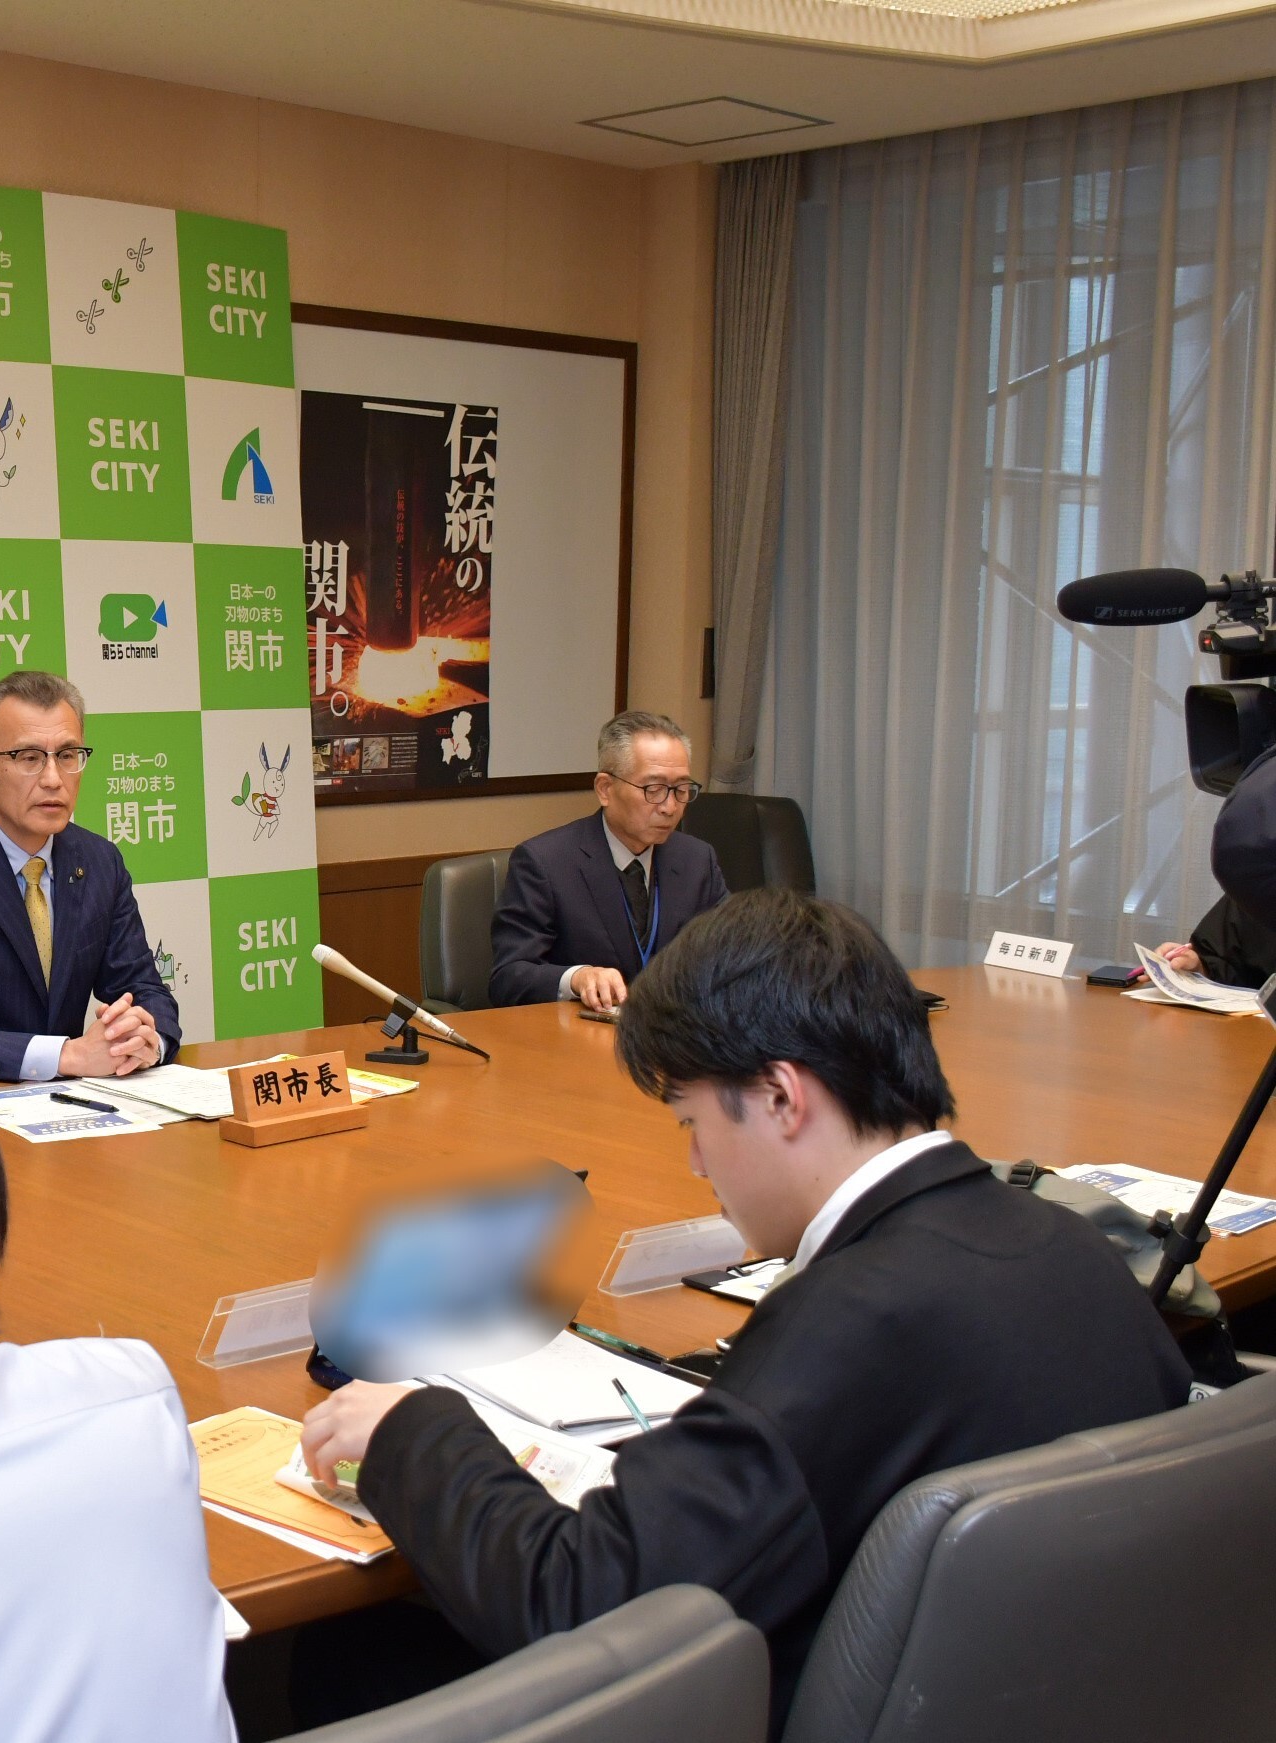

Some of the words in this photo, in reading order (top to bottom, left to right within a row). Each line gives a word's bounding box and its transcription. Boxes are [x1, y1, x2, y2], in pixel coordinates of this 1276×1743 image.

[207, 263, 266, 299] SEKI
[209, 304, 266, 338] CITY
[88, 418, 159, 450] SEKI
[91, 461, 159, 493] CITY
[254, 495, 274, 504] SEKI
[444, 403, 498, 592] 伝統の
[230, 584, 276, 600] 日本一の
[226, 605, 282, 623] 刃物のまち
[102, 644, 123, 659] 関らら
[126, 644, 158, 658] channel
[225, 630, 284, 671] 関市
[113, 753, 167, 771] 日本一の
[107, 775, 175, 794] 刃物のまち
[106, 799, 176, 845] 関市
[239, 917, 296, 951] SEKI
[998, 942, 1058, 964] 毎日新聞
[240, 957, 297, 991] CITY
[252, 1063, 343, 1107] 関市長
